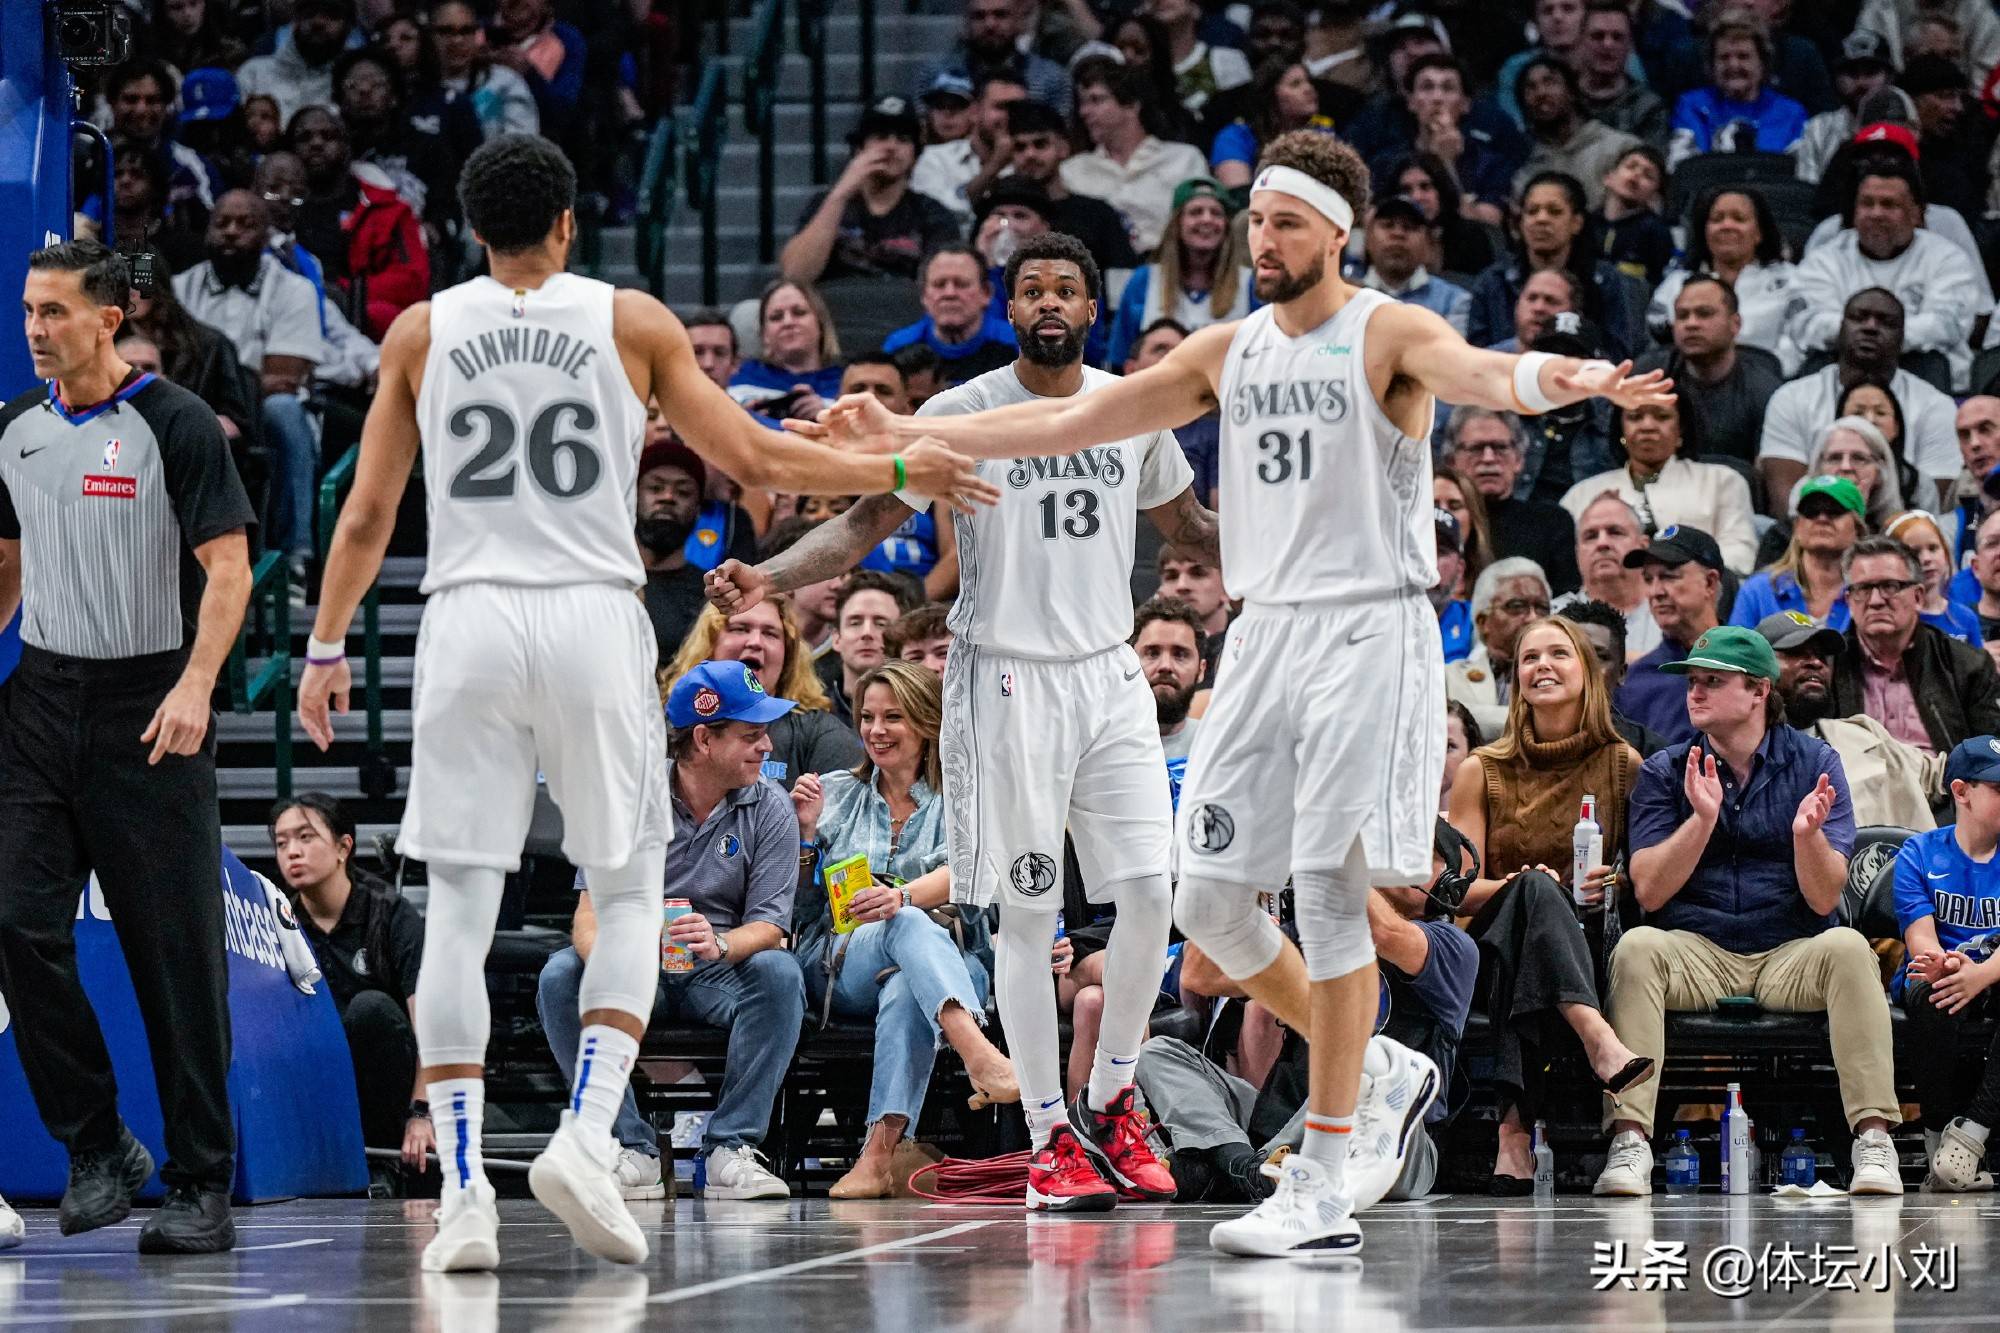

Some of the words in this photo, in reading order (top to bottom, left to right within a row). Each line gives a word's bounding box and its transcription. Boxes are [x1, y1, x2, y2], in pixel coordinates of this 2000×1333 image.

[449, 327, 597, 381] DINWIDDIE
[1231, 379, 1349, 426] MAVS
[447, 398, 603, 501] 26
[1007, 447, 1124, 489] MAVS
[1257, 428, 1312, 485] 31
[84, 479, 135, 494] Emirates
[1039, 488, 1101, 540] 13
